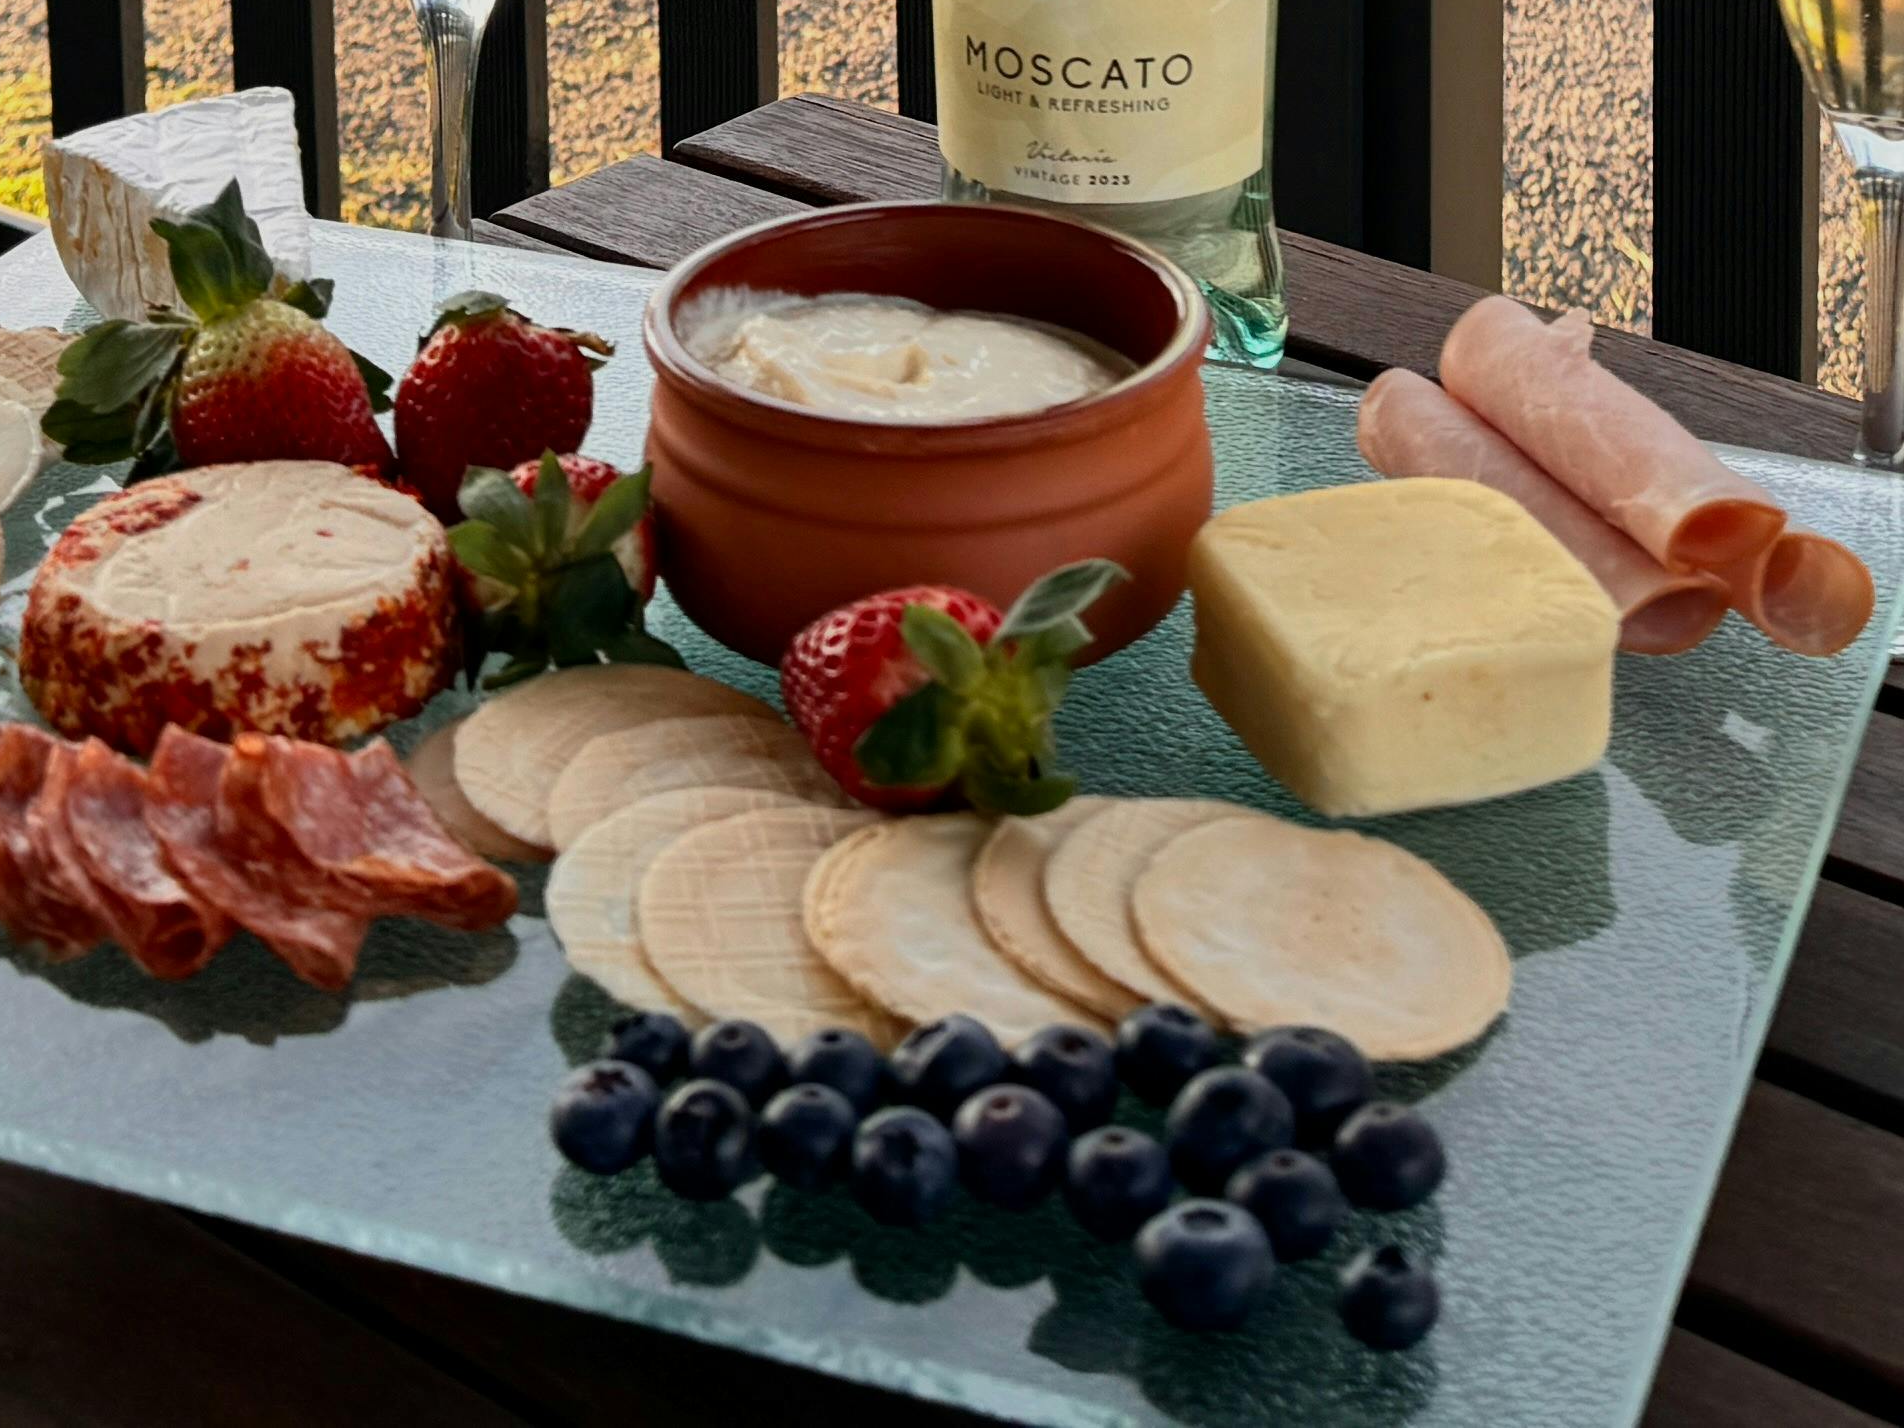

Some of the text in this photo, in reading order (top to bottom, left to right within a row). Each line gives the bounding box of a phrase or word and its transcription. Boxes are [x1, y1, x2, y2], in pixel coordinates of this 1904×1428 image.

[966, 35, 1193, 89] MOSCATO
[977, 81, 1023, 105] LIGHT
[1048, 97, 1171, 114] REFRESHING
[1014, 165, 1132, 186] VINTAGE 2023
